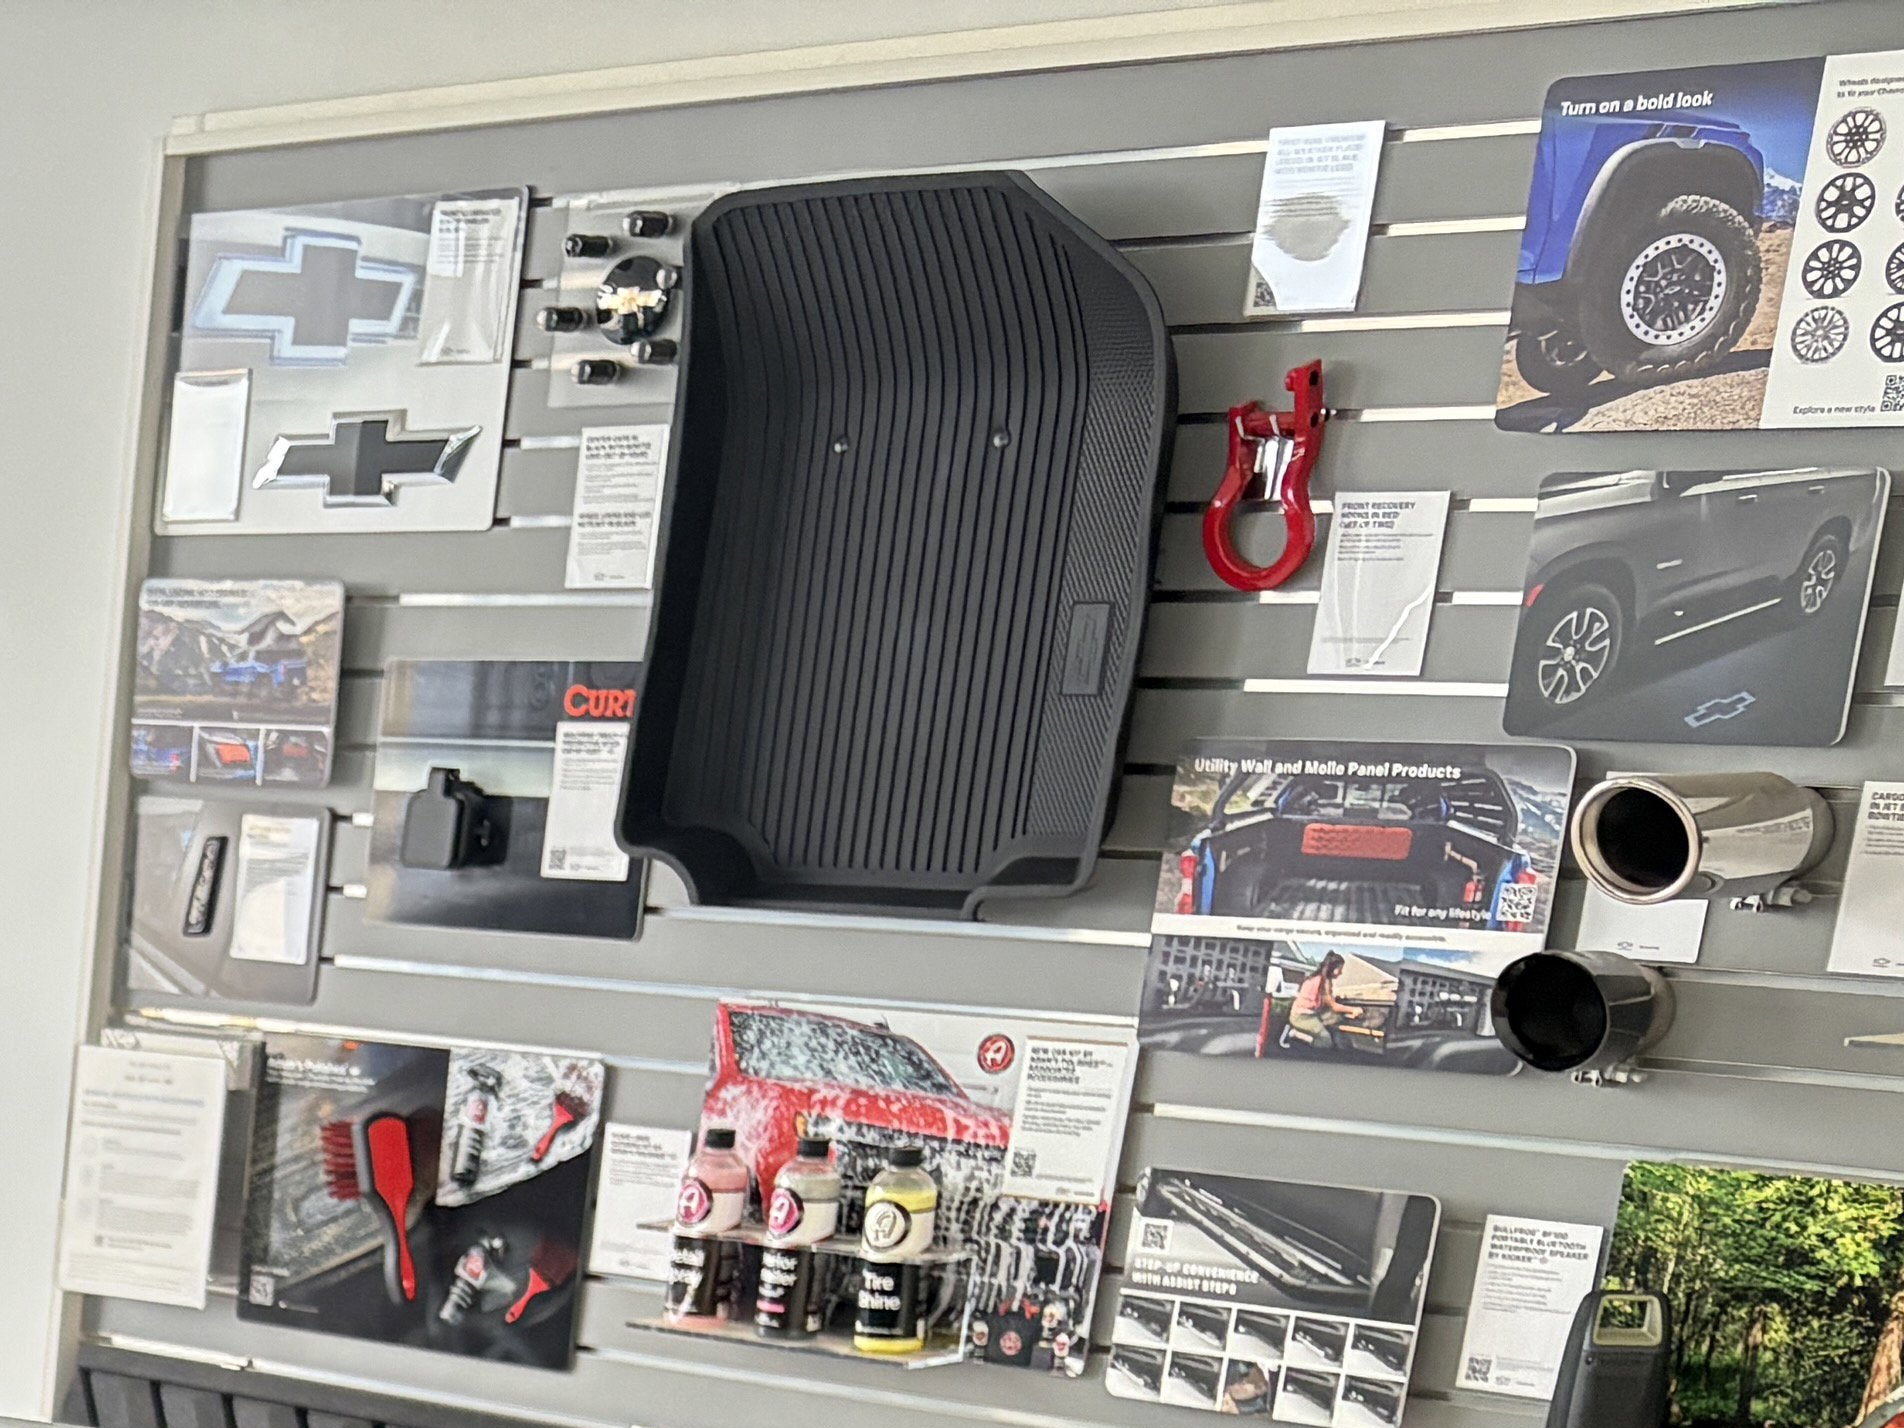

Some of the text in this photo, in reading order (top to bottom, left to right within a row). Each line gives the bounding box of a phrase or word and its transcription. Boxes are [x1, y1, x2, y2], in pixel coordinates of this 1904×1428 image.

[1561, 90, 1714, 116] Turn on a bold look
[1854, 405, 1876, 414] style
[1342, 502, 1416, 510] FRONT RECOVERY
[1194, 758, 1462, 780] Utility Wall and Molle Panel Products
[1395, 904, 1492, 921] Fit for any lifestyle
[862, 1270, 895, 1291] Tire
[1162, 1274, 1201, 1291] ASSIST
[1182, 1262, 1260, 1284] CONVENIENCE
[858, 1290, 902, 1312] Shine
